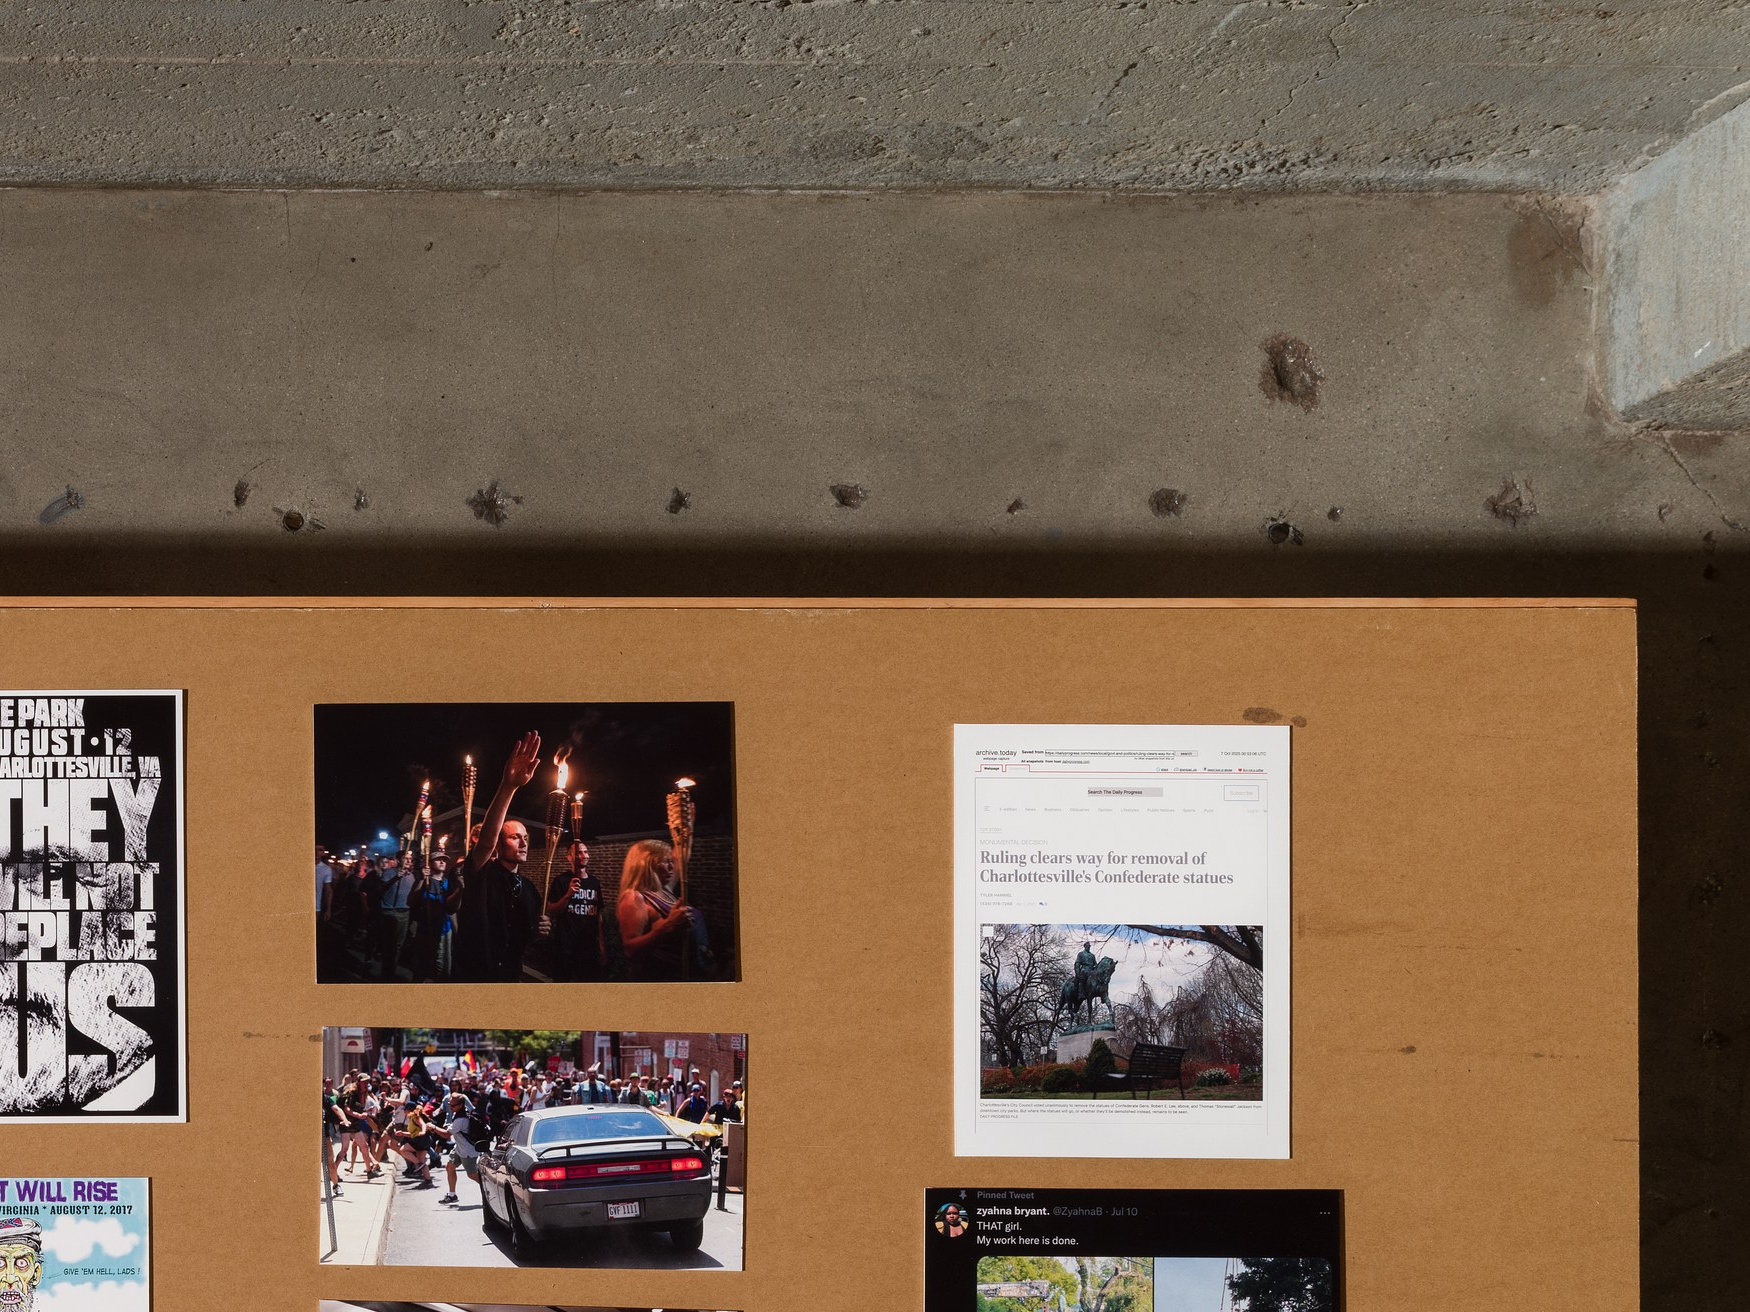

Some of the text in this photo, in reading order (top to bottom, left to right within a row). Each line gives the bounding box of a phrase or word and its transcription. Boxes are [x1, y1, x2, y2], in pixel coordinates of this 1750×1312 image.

[18, 698, 85, 727] PARK
[103, 727, 132, 756] 12
[975, 749, 1017, 758] archive.today
[138, 756, 162, 778] VA
[980, 850, 1208, 867] Ruling clears way for removal of
[980, 869, 1234, 884] Charlottesville's Confederate statues
[76, 862, 160, 911] NOT
[15, 1180, 67, 1203] WILL
[73, 1180, 118, 1202] RISE
[977, 1190, 1034, 1200] Pinned Tweet
[50, 1205, 90, 1215] AUGUST
[110, 1205, 133, 1215] 2017
[976, 1206, 1138, 1217] zyahna bryant. @ZyahnaB Jul 10
[976, 1221, 1022, 1233] THAT girl.
[977, 1235, 1079, 1246] My work here is done.
[63, 1267, 79, 1276] GIVE
[117, 1267, 135, 1276] LADS
